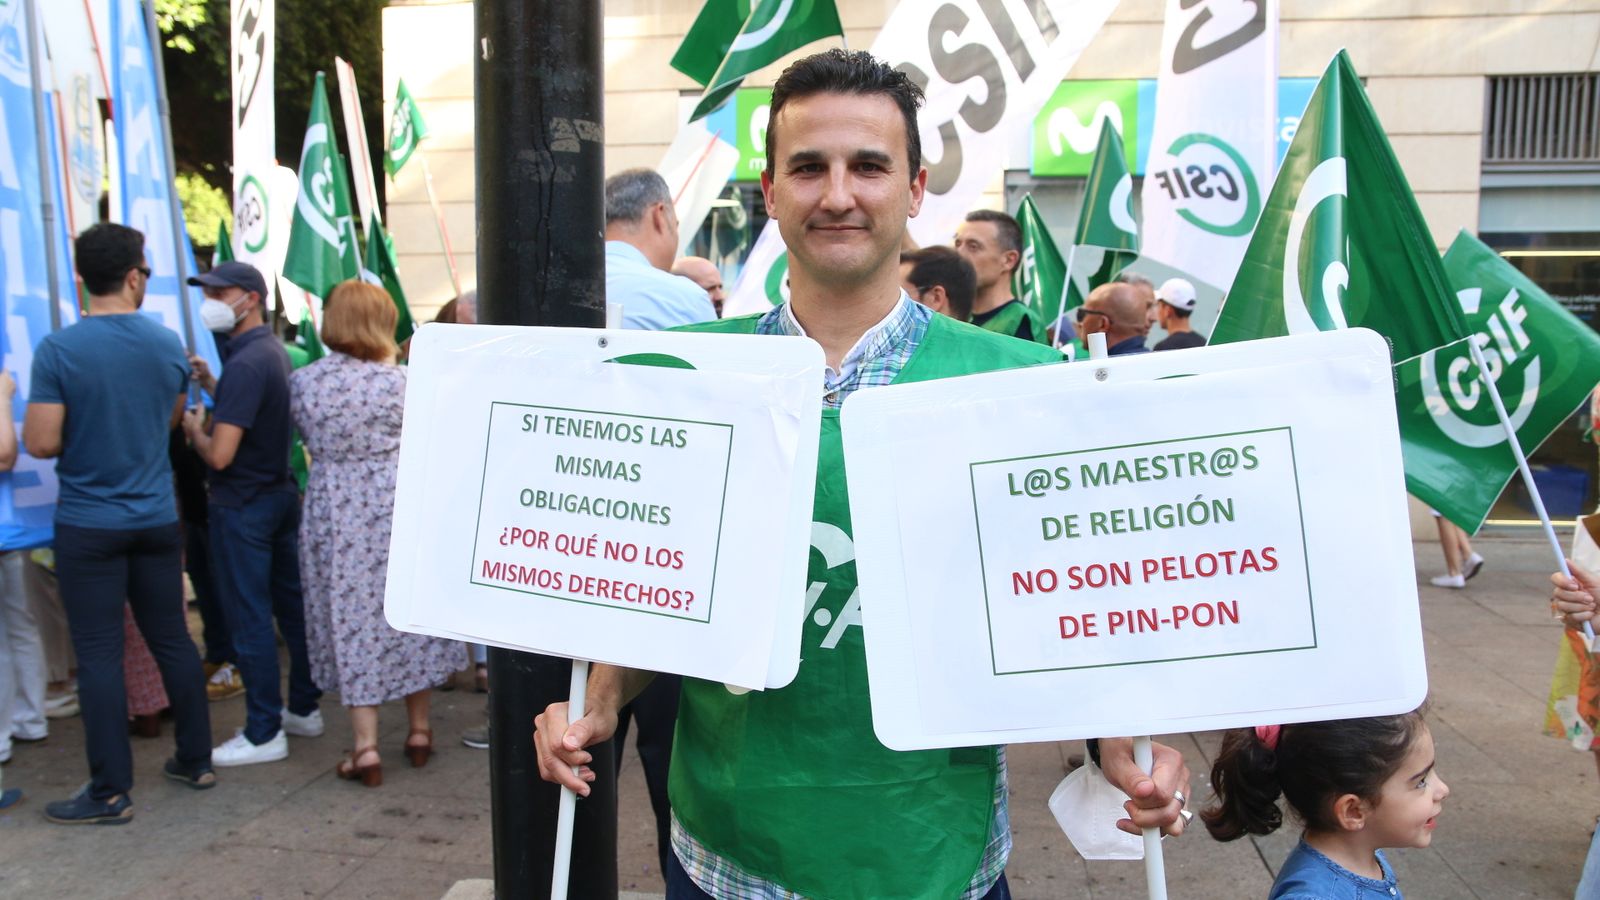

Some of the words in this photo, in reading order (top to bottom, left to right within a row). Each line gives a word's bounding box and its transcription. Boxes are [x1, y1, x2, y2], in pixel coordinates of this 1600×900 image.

[1449, 288, 1530, 411] CSIF
[521, 413, 538, 433] SI
[544, 415, 643, 444] TENEMOS
[650, 427, 687, 448] LAS
[555, 454, 642, 482] MISMAS
[1007, 466, 1071, 497] L@S
[1080, 445, 1259, 488] MAESTR@S
[519, 488, 671, 525] OBLIGACIONES
[1041, 513, 1080, 541] DE
[1090, 494, 1235, 536] RELIGIÓN
[499, 527, 549, 550] ¿POR
[554, 533, 598, 557] QUÉ
[604, 540, 638, 562] NO
[644, 546, 684, 570] LOS
[1012, 569, 1059, 595] NO
[1067, 561, 1132, 591] SON
[1142, 547, 1279, 583] PELOTAS
[482, 560, 563, 590] MISMOS
[568, 574, 695, 611] DERECHOS?
[1058, 613, 1098, 640] DE
[1107, 600, 1240, 636] PIN-PON
